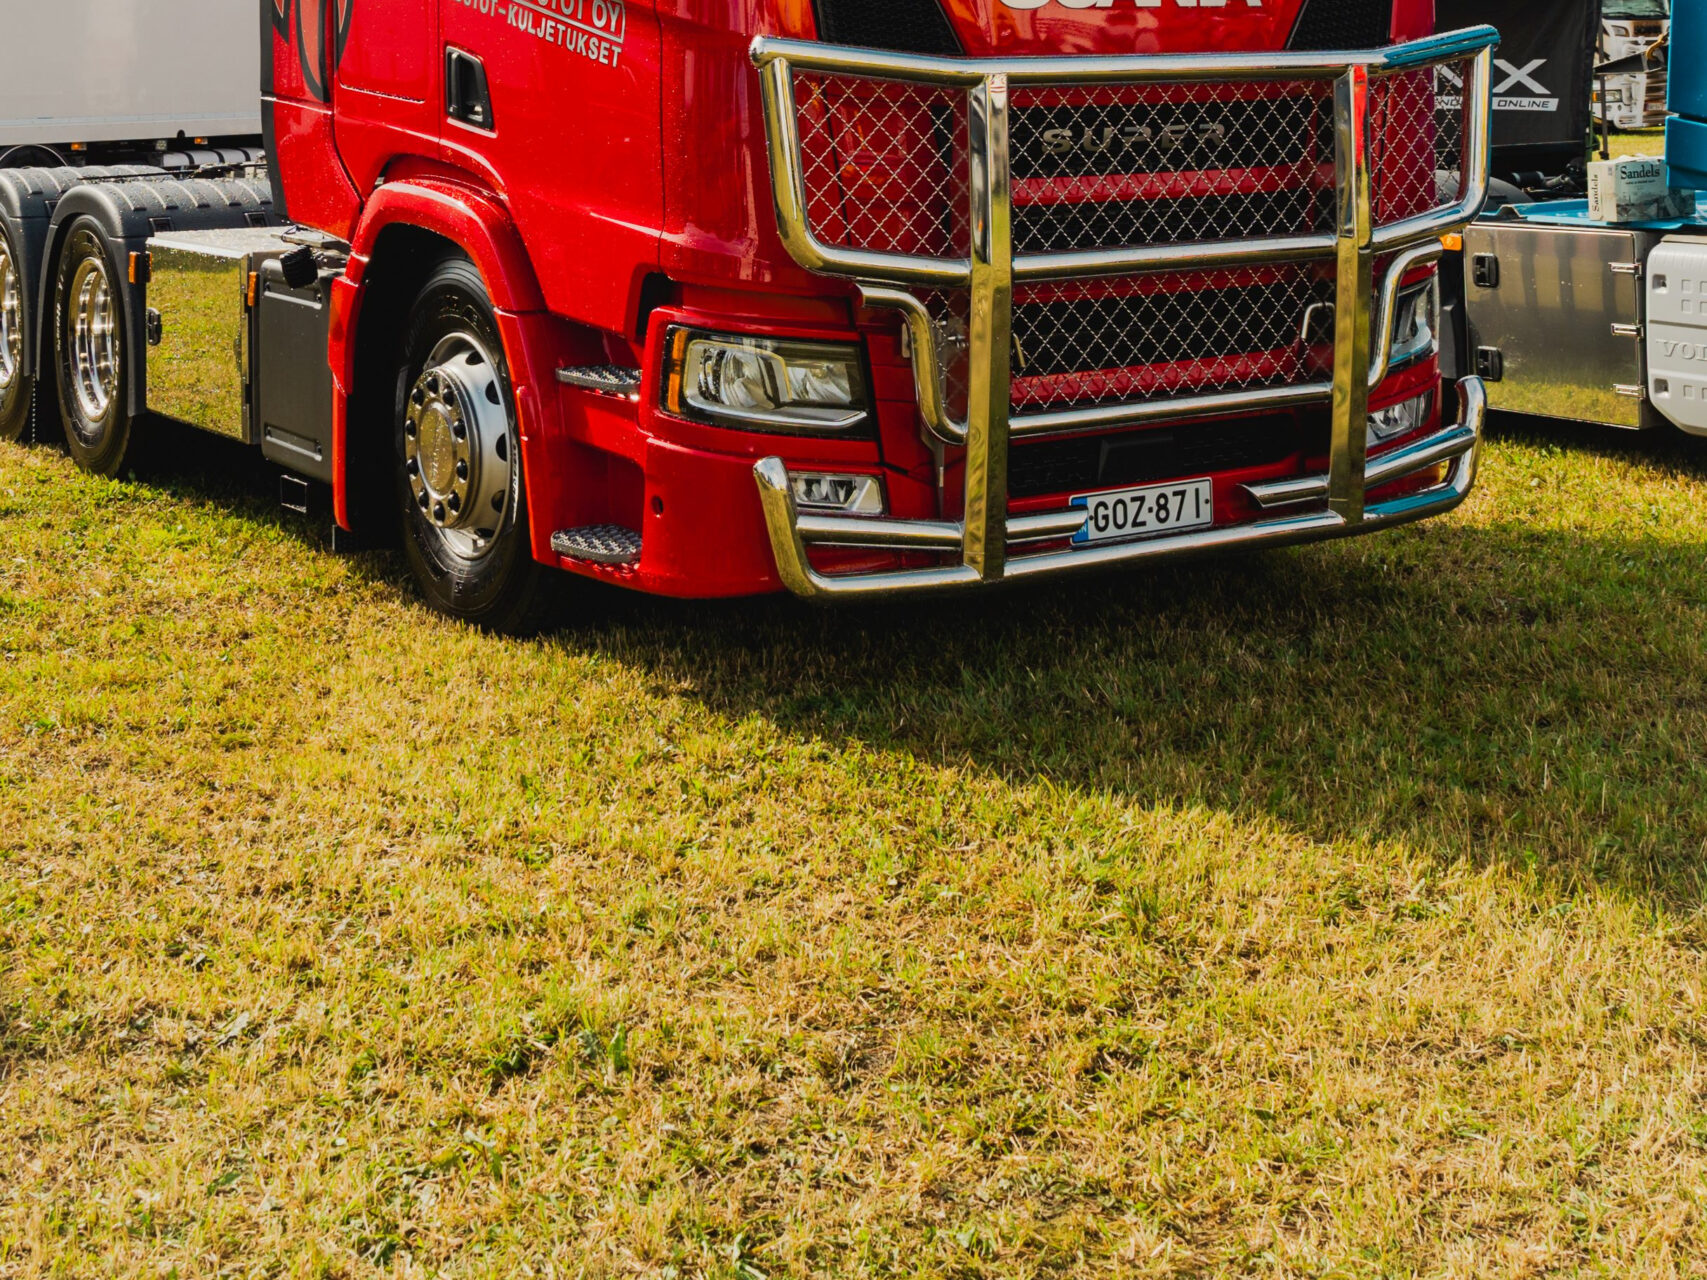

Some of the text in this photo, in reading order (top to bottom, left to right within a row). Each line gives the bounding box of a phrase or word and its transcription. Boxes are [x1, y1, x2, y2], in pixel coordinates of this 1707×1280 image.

[1497, 99, 1550, 109] ONLINE
[1042, 123, 1226, 154] SUPER
[1620, 164, 1660, 180] Sandels
[1591, 174, 1600, 212] Sandels
[1093, 487, 1200, 533] GOZ-871
